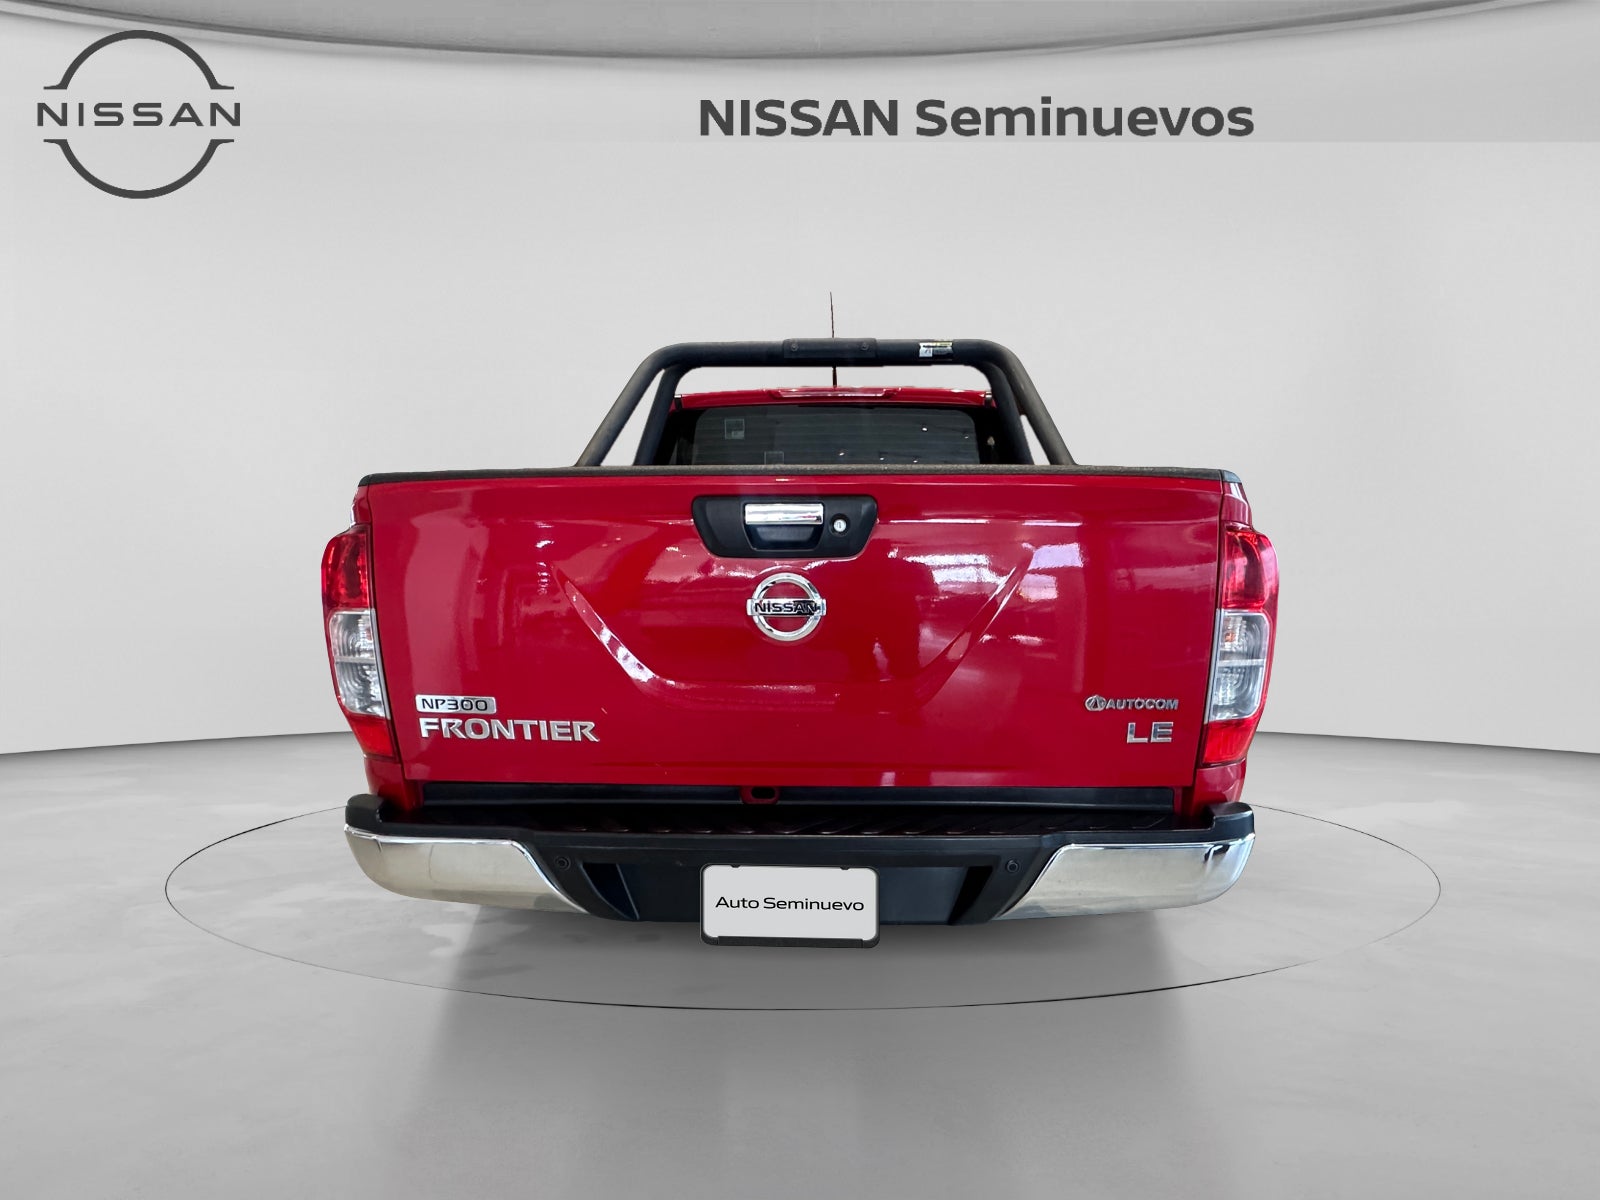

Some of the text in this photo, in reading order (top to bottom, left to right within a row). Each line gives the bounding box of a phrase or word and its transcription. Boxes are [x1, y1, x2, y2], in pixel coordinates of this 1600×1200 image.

[754, 602, 818, 613] NISSAN
[421, 698, 489, 712] NP300
[1105, 698, 1179, 710] AUTOCOM
[419, 717, 600, 742] FRONTIER
[1126, 721, 1174, 744] LE
